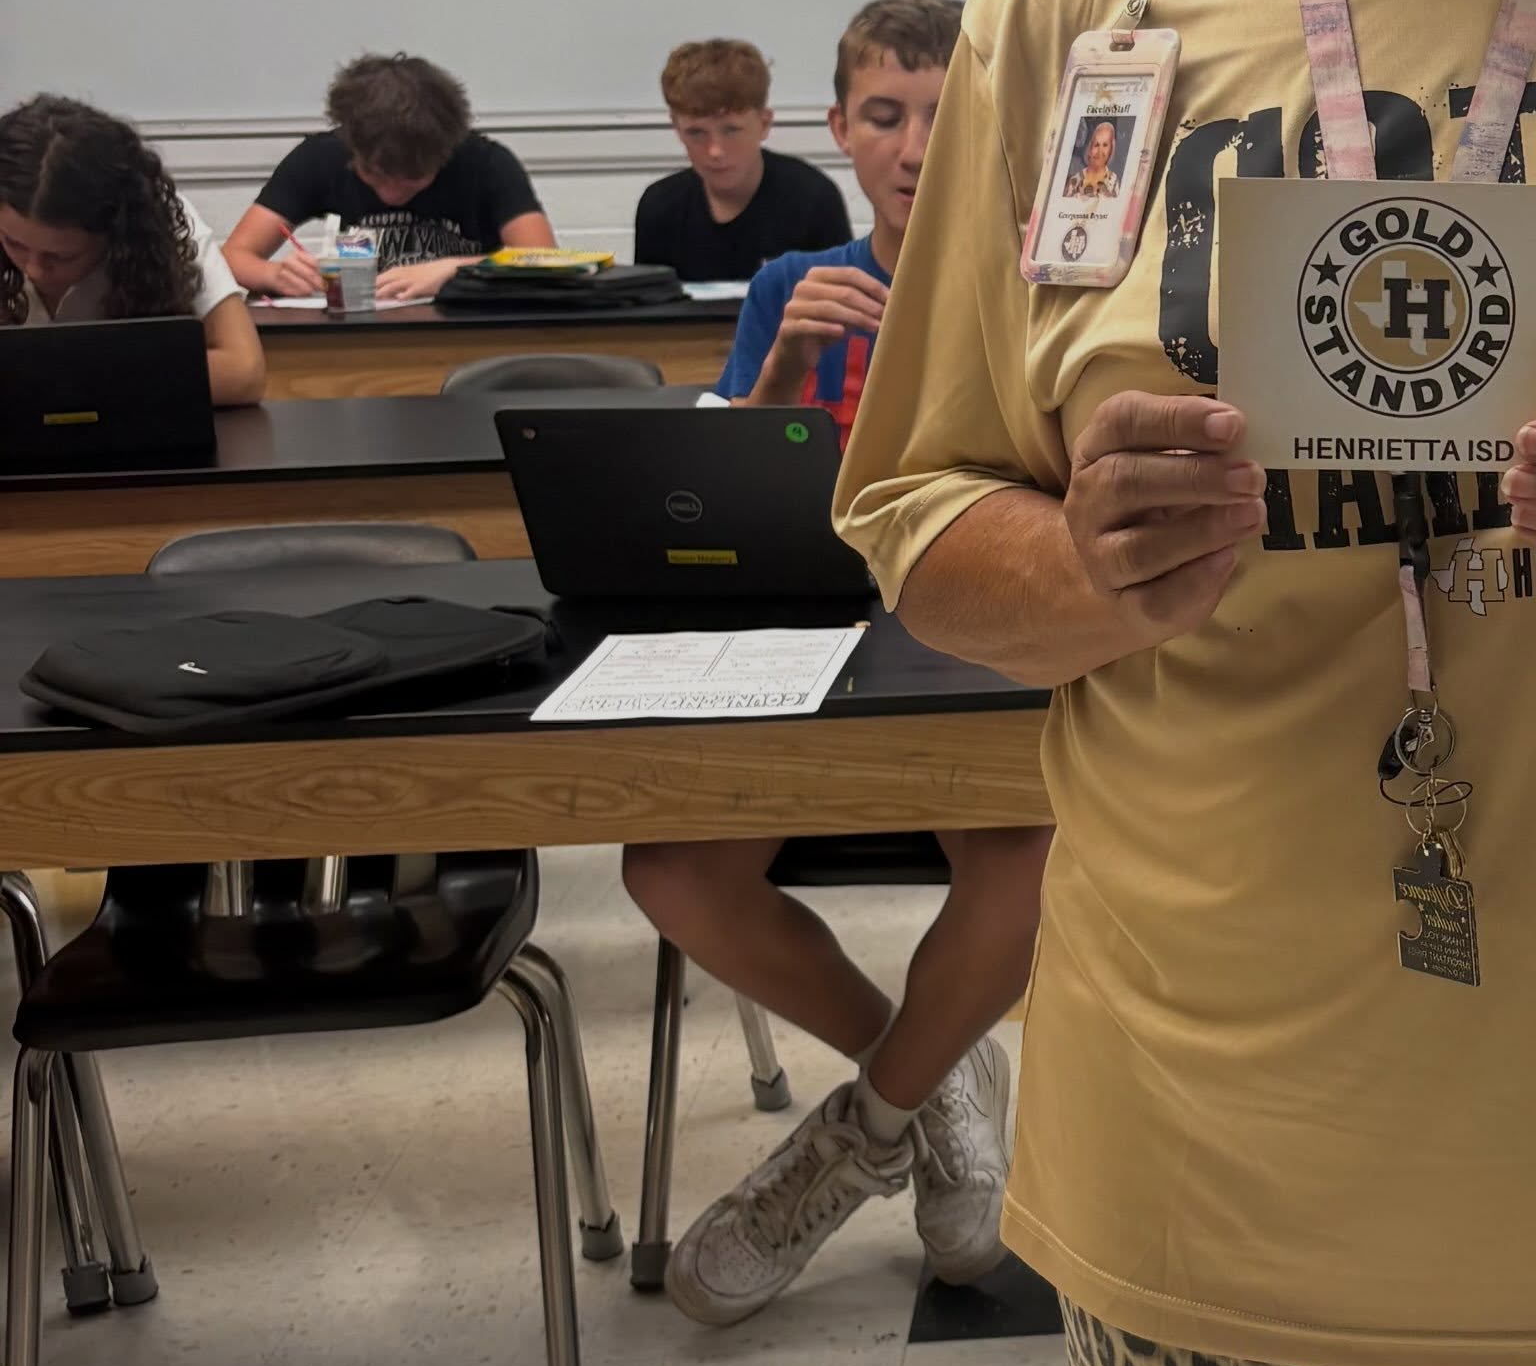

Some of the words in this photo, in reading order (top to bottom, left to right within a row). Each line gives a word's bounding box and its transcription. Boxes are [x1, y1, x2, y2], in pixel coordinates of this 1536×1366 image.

[1339, 207, 1474, 259] GOLD
[1384, 277, 1450, 339] H
[1304, 294, 1511, 412] STANDARD
[1293, 437, 1460, 461] HENRIETTA
[1468, 440, 1515, 462] ISD
